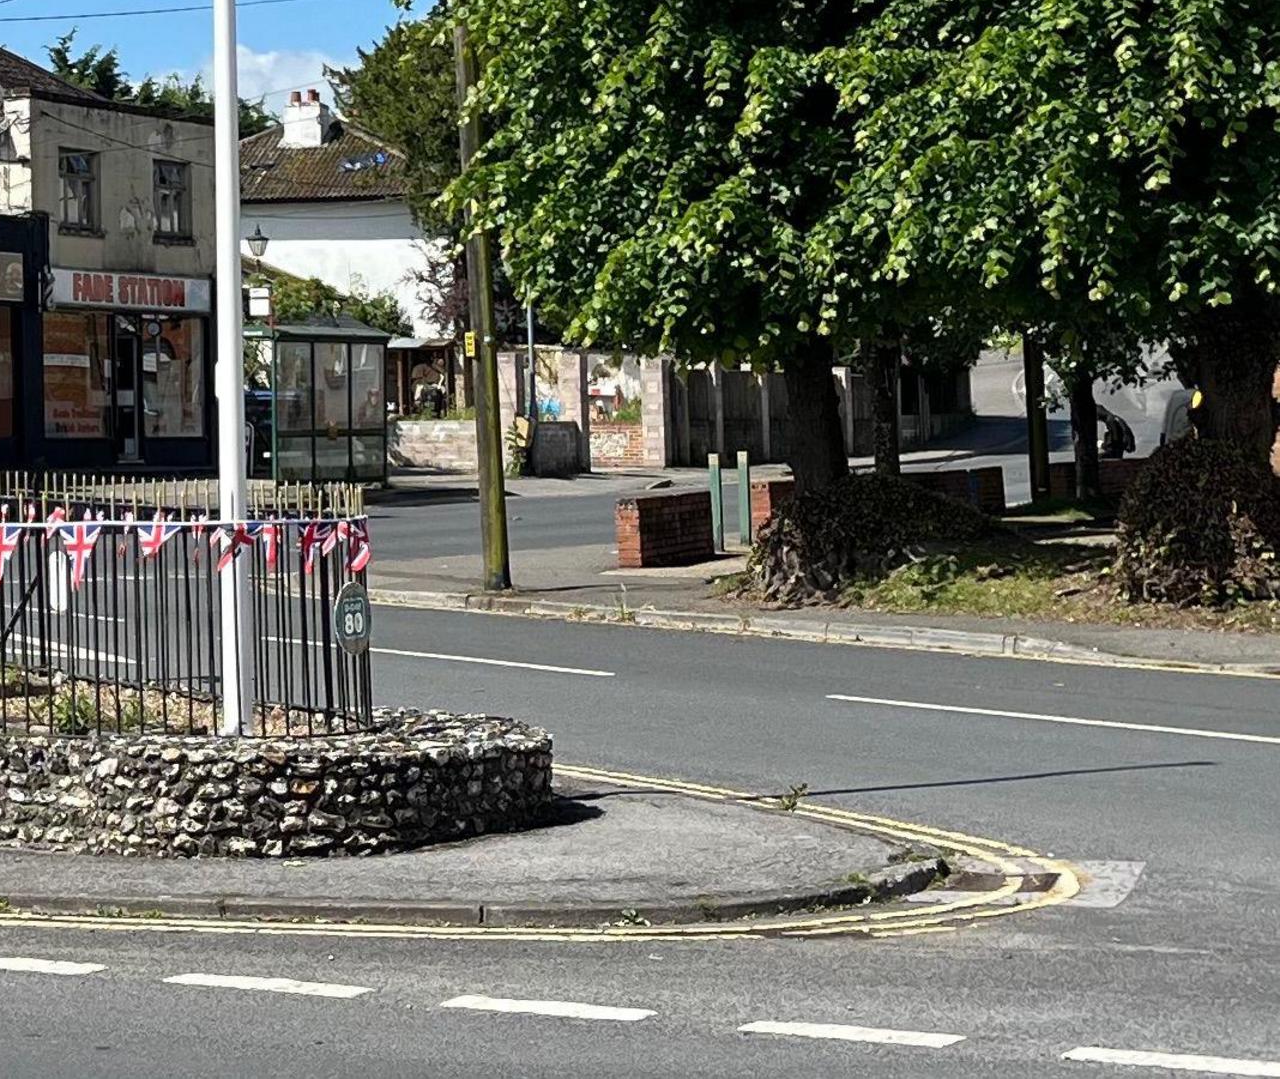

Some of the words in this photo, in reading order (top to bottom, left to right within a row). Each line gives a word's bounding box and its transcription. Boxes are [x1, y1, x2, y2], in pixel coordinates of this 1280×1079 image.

[72, 272, 114, 303] FADE
[118, 275, 186, 307] STATION
[344, 612, 363, 634] 80
